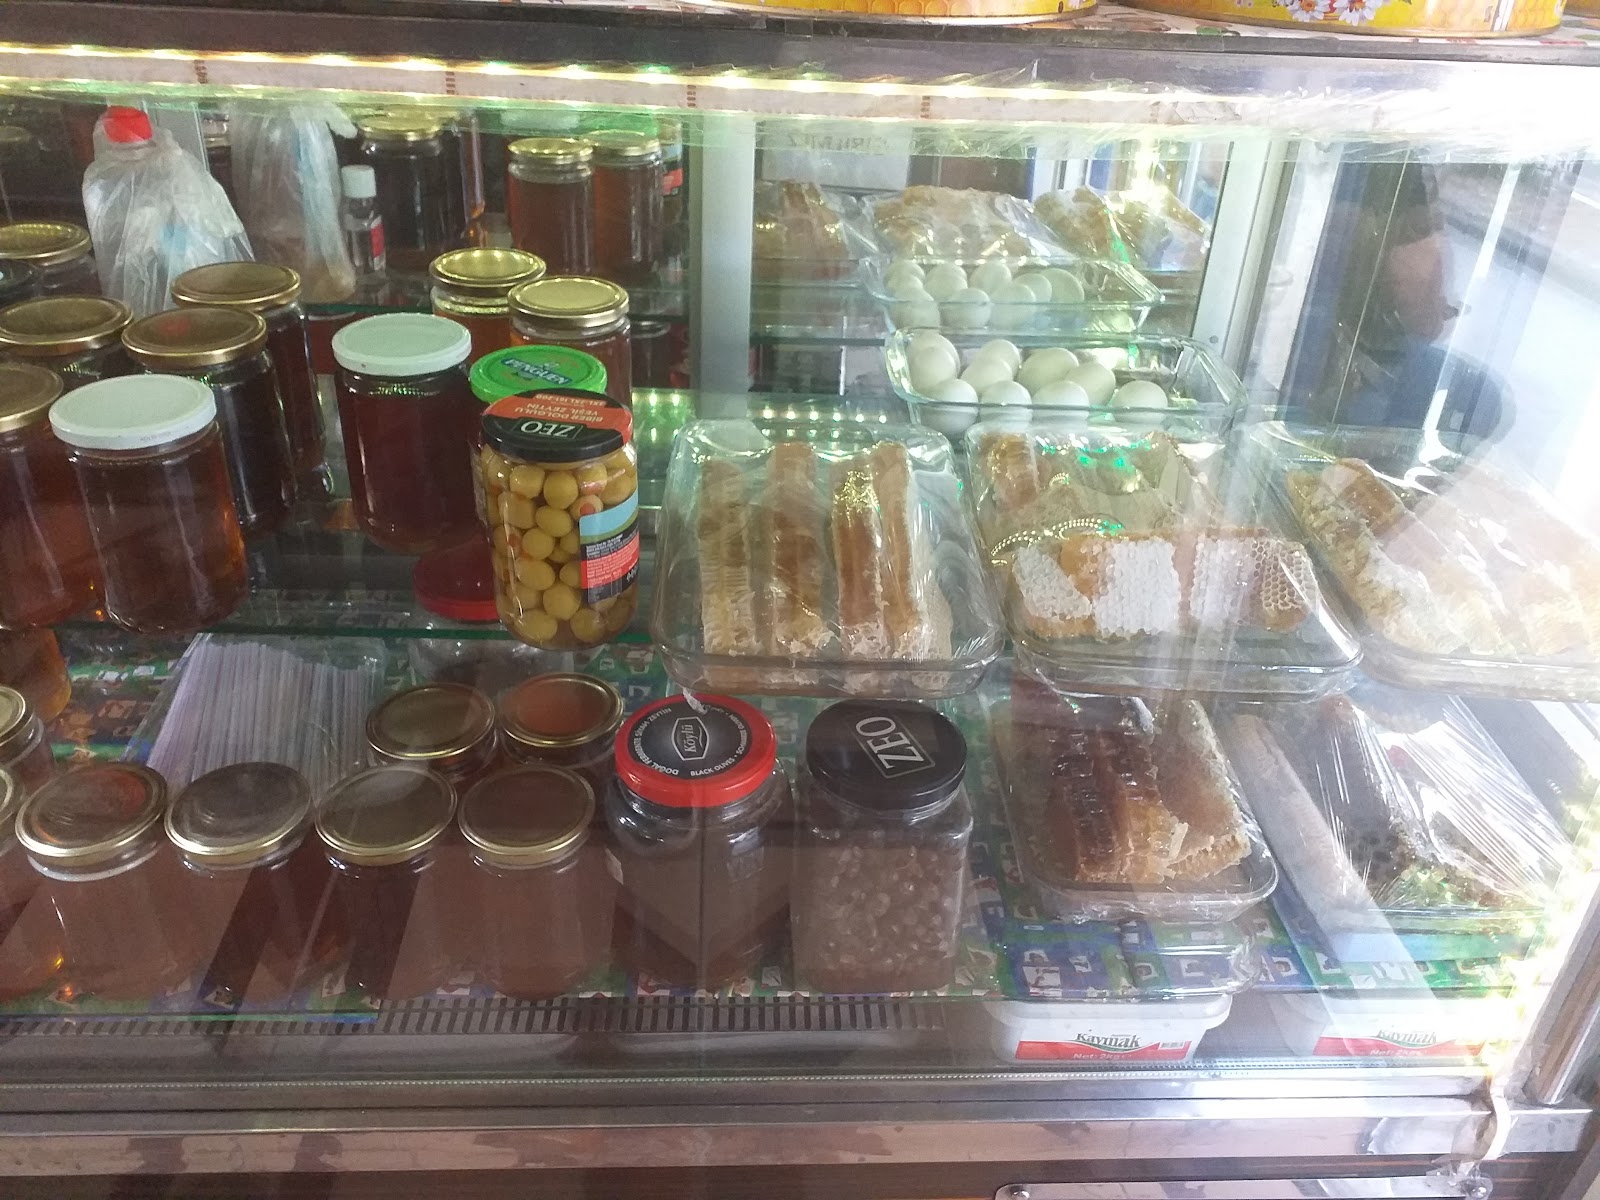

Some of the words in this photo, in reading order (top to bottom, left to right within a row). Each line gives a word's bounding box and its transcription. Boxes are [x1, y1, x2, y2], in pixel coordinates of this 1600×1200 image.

[505, 359, 570, 384] PENGUEN
[514, 406, 571, 418] DOLGULU
[526, 402, 567, 413] ZEYTİN
[571, 408, 598, 416] YEŞİL
[571, 414, 604, 422] BİBER
[520, 420, 576, 437] ZEO
[680, 724, 699, 753] Köylü
[856, 716, 924, 769] ZEO
[651, 762, 680, 776] DOĞAL
[690, 767, 714, 777] BLACK
[714, 757, 735, 771] OLIVES
[1075, 1032, 1141, 1048] Kaymak
